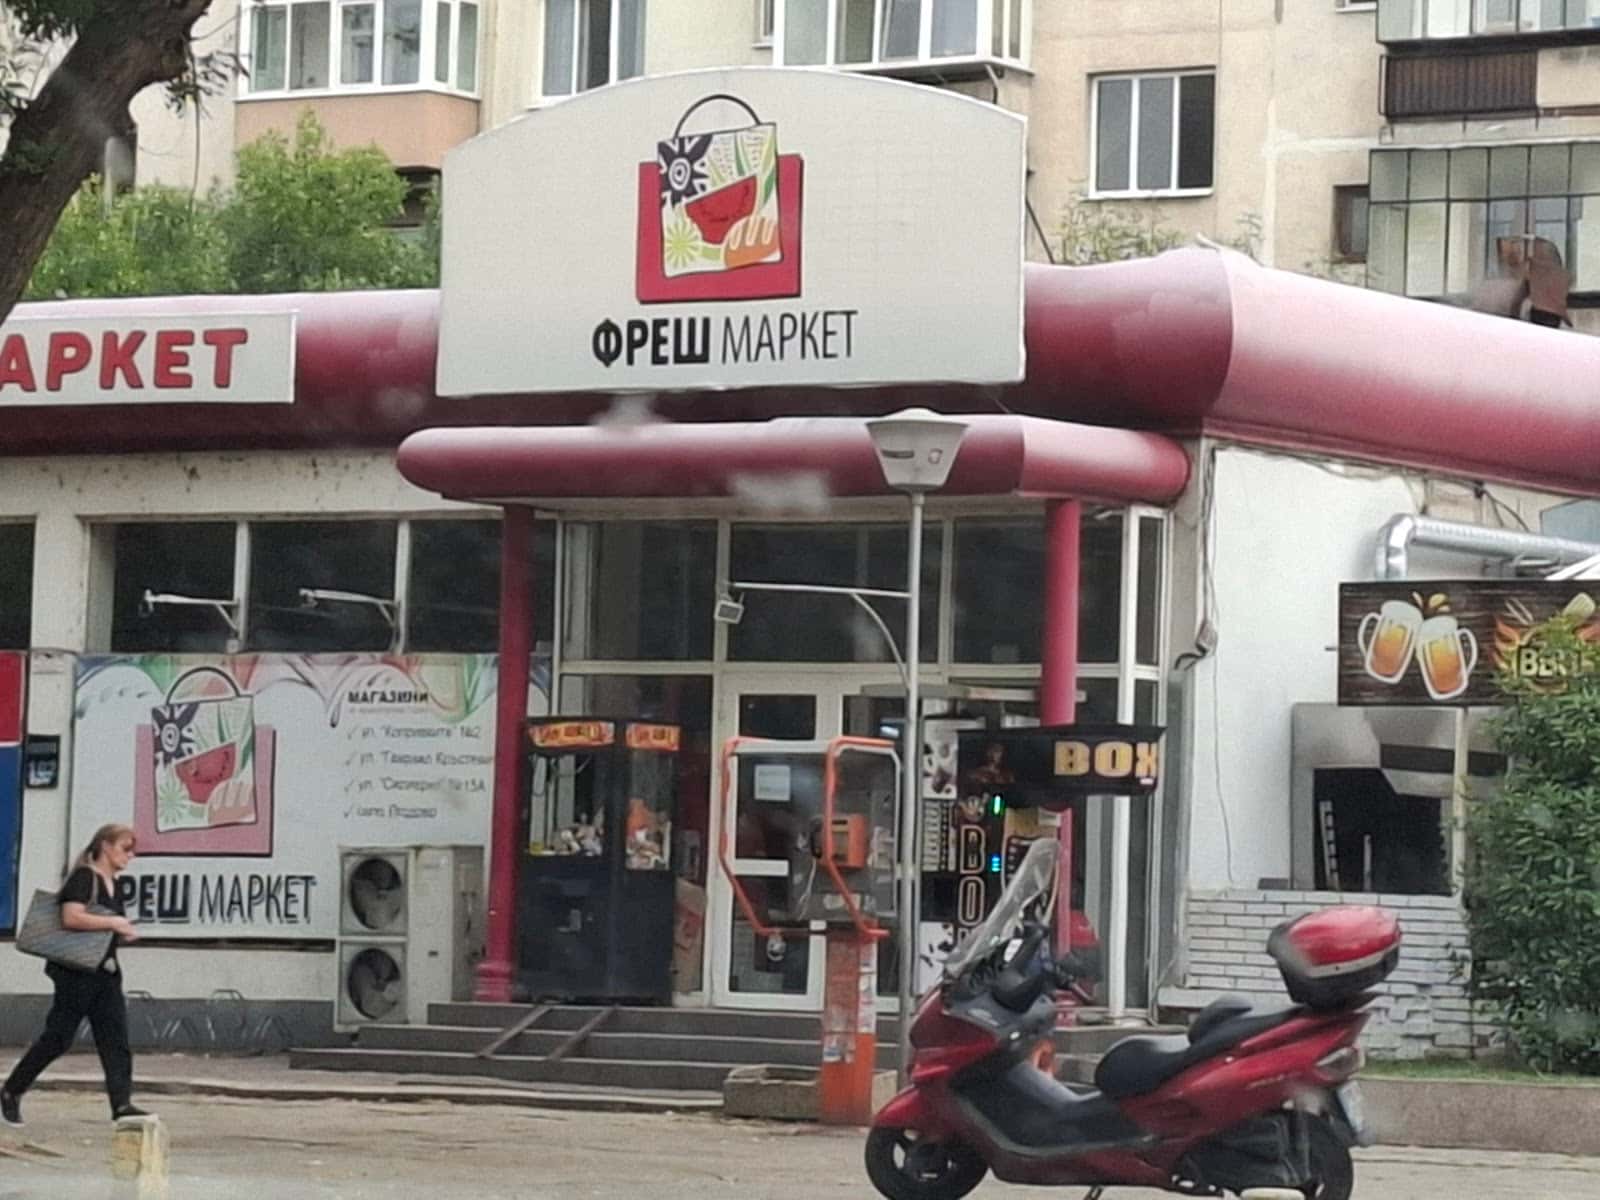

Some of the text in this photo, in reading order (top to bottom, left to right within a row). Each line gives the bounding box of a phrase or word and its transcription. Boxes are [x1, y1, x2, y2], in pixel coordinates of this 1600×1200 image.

[0, 328, 248, 392] АРКЕТ
[592, 310, 859, 368] ФРЕШ МАРКЕТ
[1054, 741, 1158, 778] BOX
[119, 874, 317, 921] РЕШ МАРКЕТ
